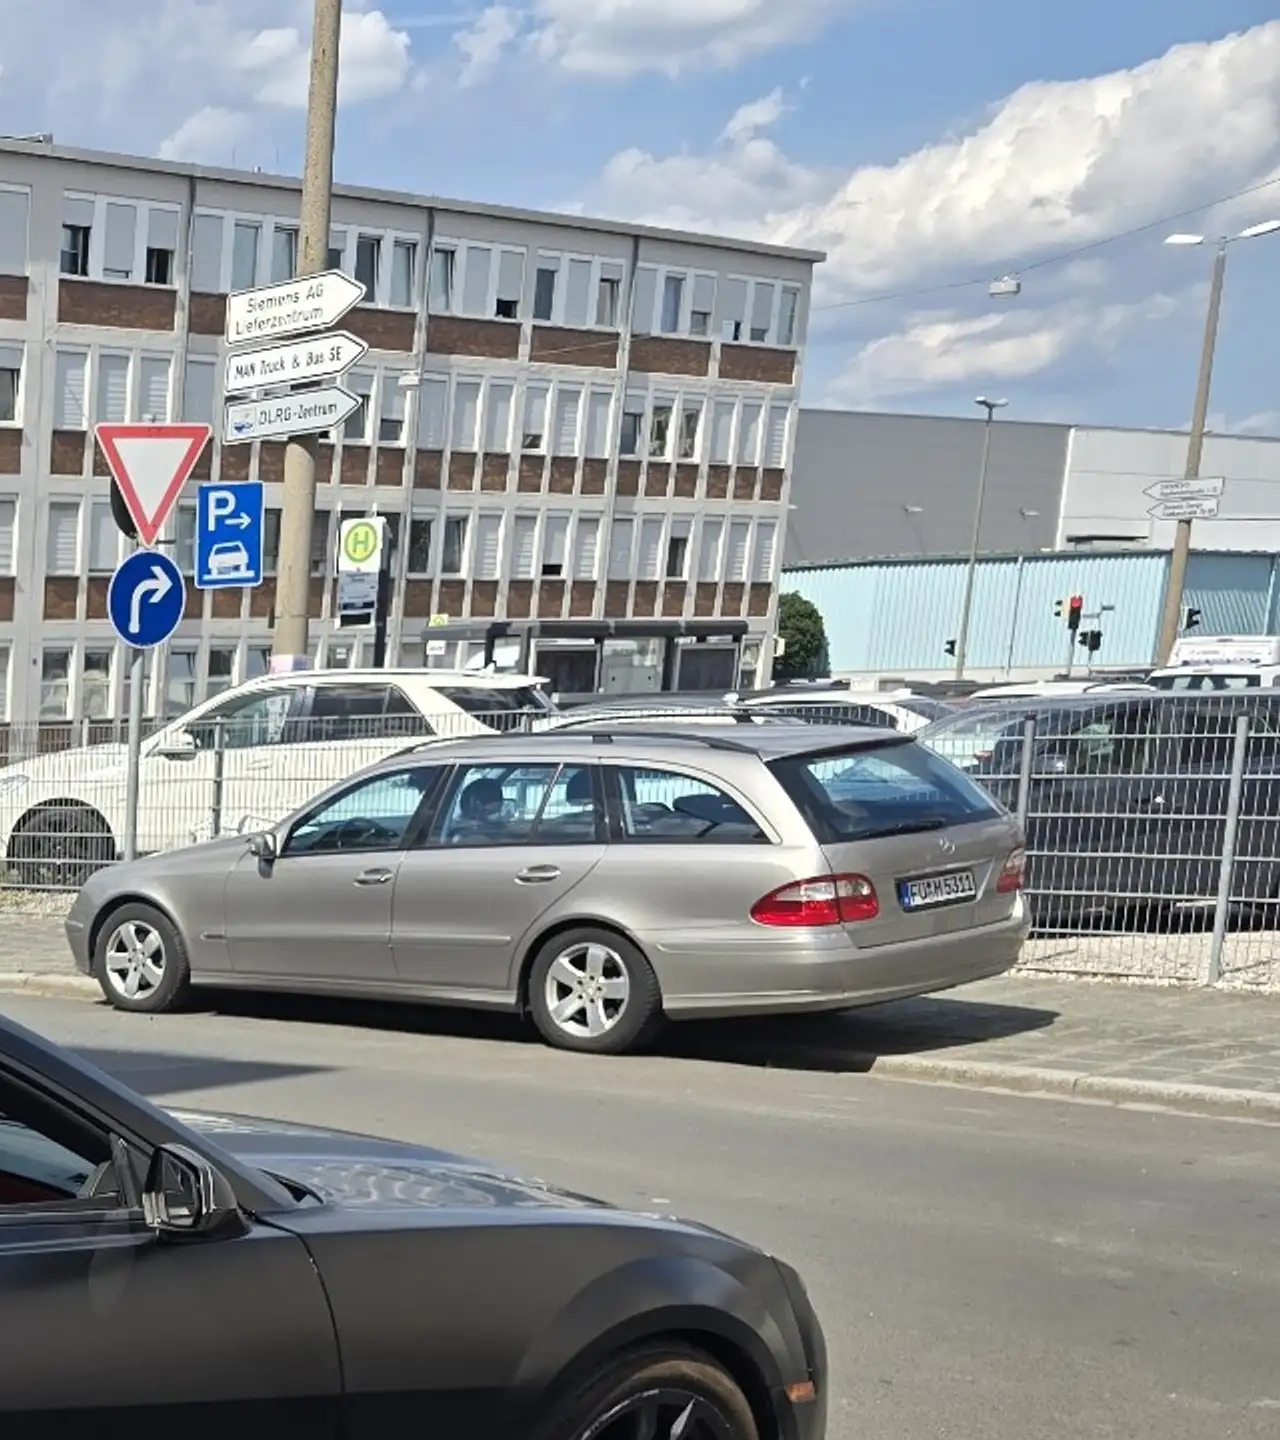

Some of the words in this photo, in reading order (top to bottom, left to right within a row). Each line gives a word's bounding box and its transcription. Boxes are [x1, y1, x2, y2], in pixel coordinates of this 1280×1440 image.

[246, 291, 300, 313] Siemens
[305, 283, 324, 300] AG
[235, 307, 324, 335] Lieferzentrum
[235, 364, 255, 380] MAN
[259, 356, 285, 375] Truck
[291, 354, 300, 369] &
[306, 351, 325, 366] Bus
[328, 346, 342, 361] SE
[258, 403, 338, 425] DLRG-Zentrum
[208, 490, 236, 532] P
[352, 530, 369, 553] H
